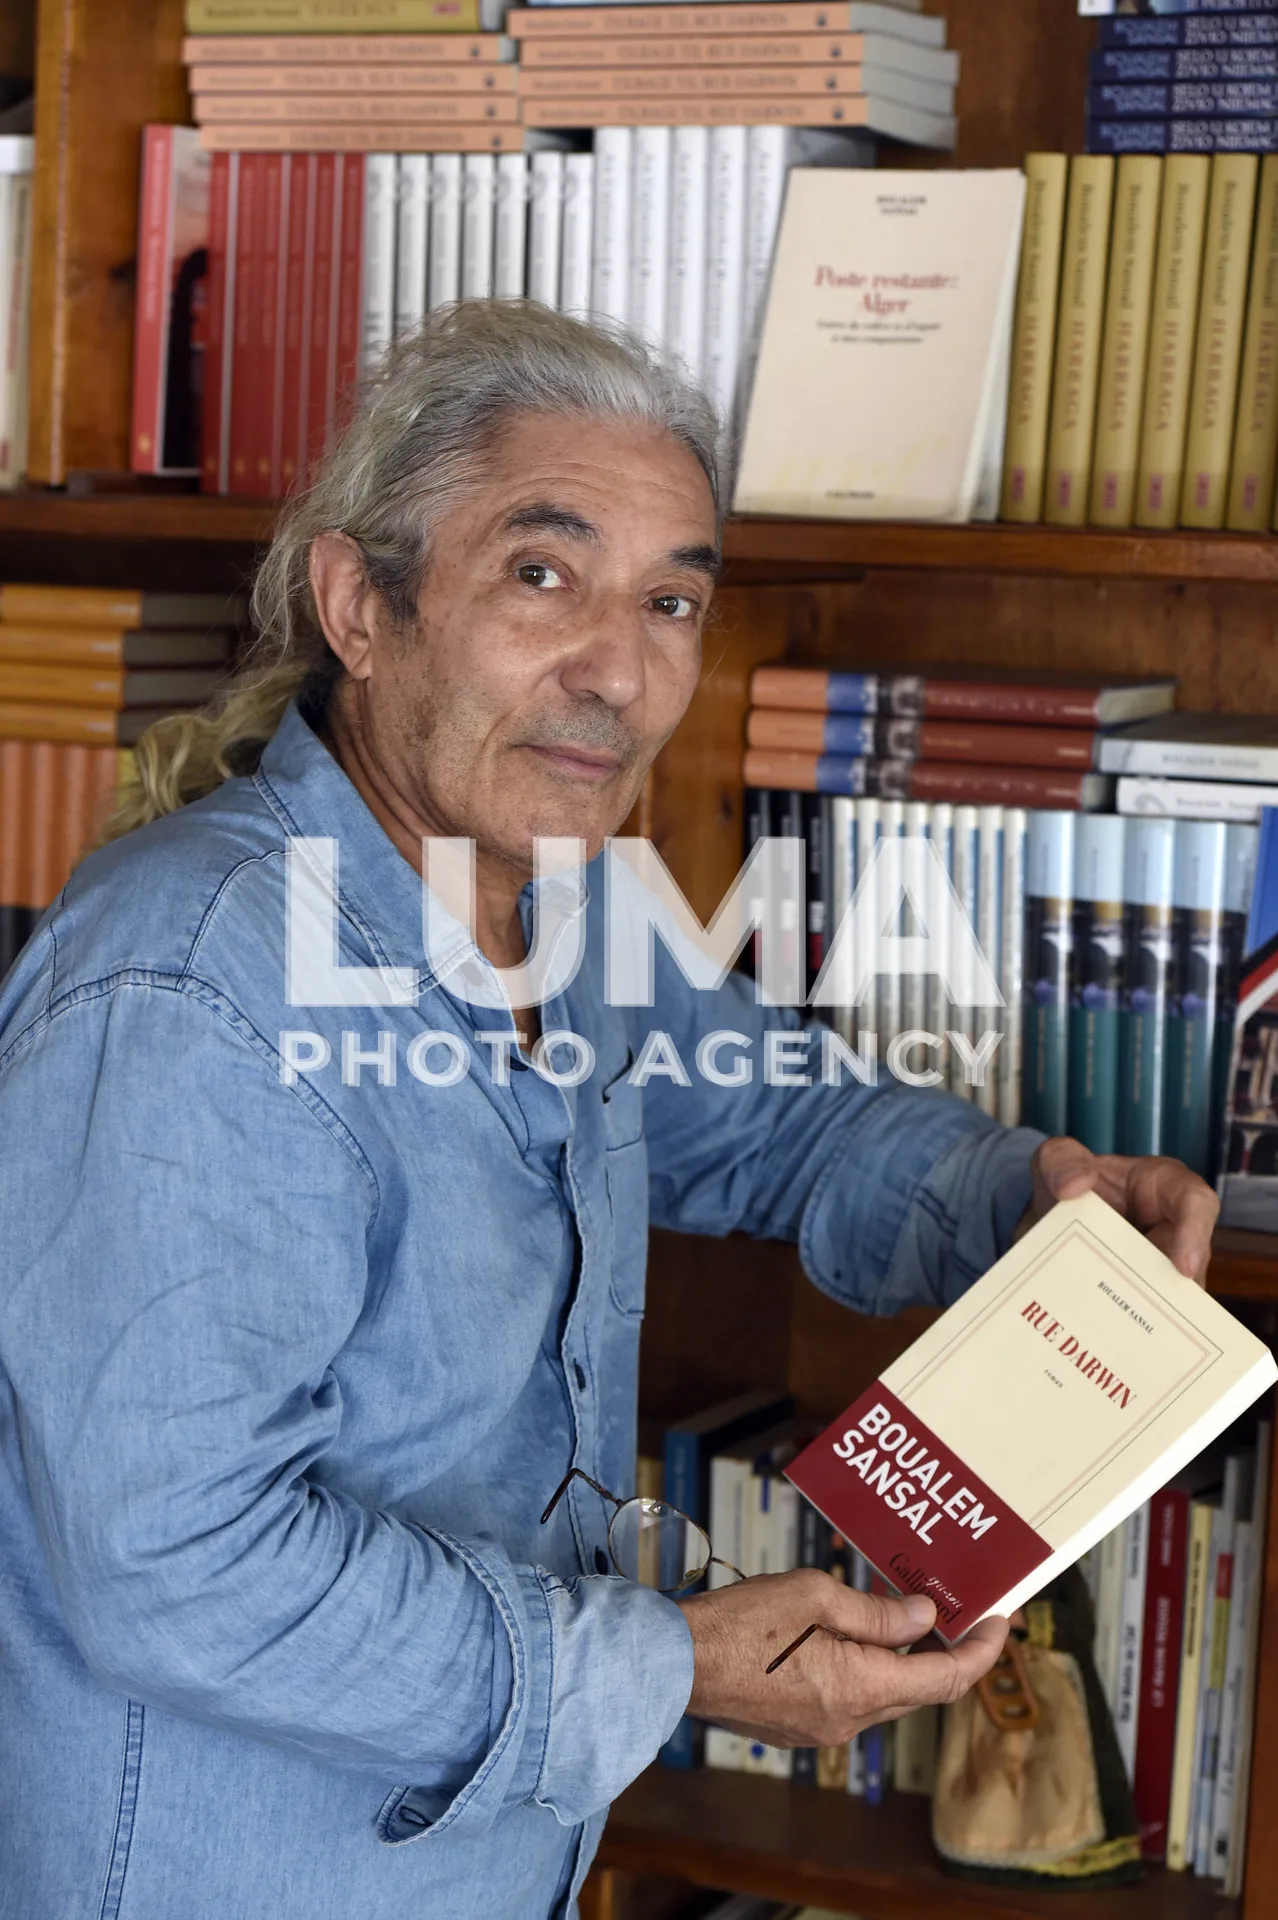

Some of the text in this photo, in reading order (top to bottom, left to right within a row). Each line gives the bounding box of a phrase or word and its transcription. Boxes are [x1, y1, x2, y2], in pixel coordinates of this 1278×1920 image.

[815, 266, 867, 288] Poste
[856, 293, 911, 316] Alger
[1098, 1281, 1154, 1335] BOUALEM SANSAL
[1020, 1300, 1137, 1410] RUE DARWIN
[832, 1429, 943, 1546] SANSAL
[858, 1402, 999, 1541] BOUALEM
